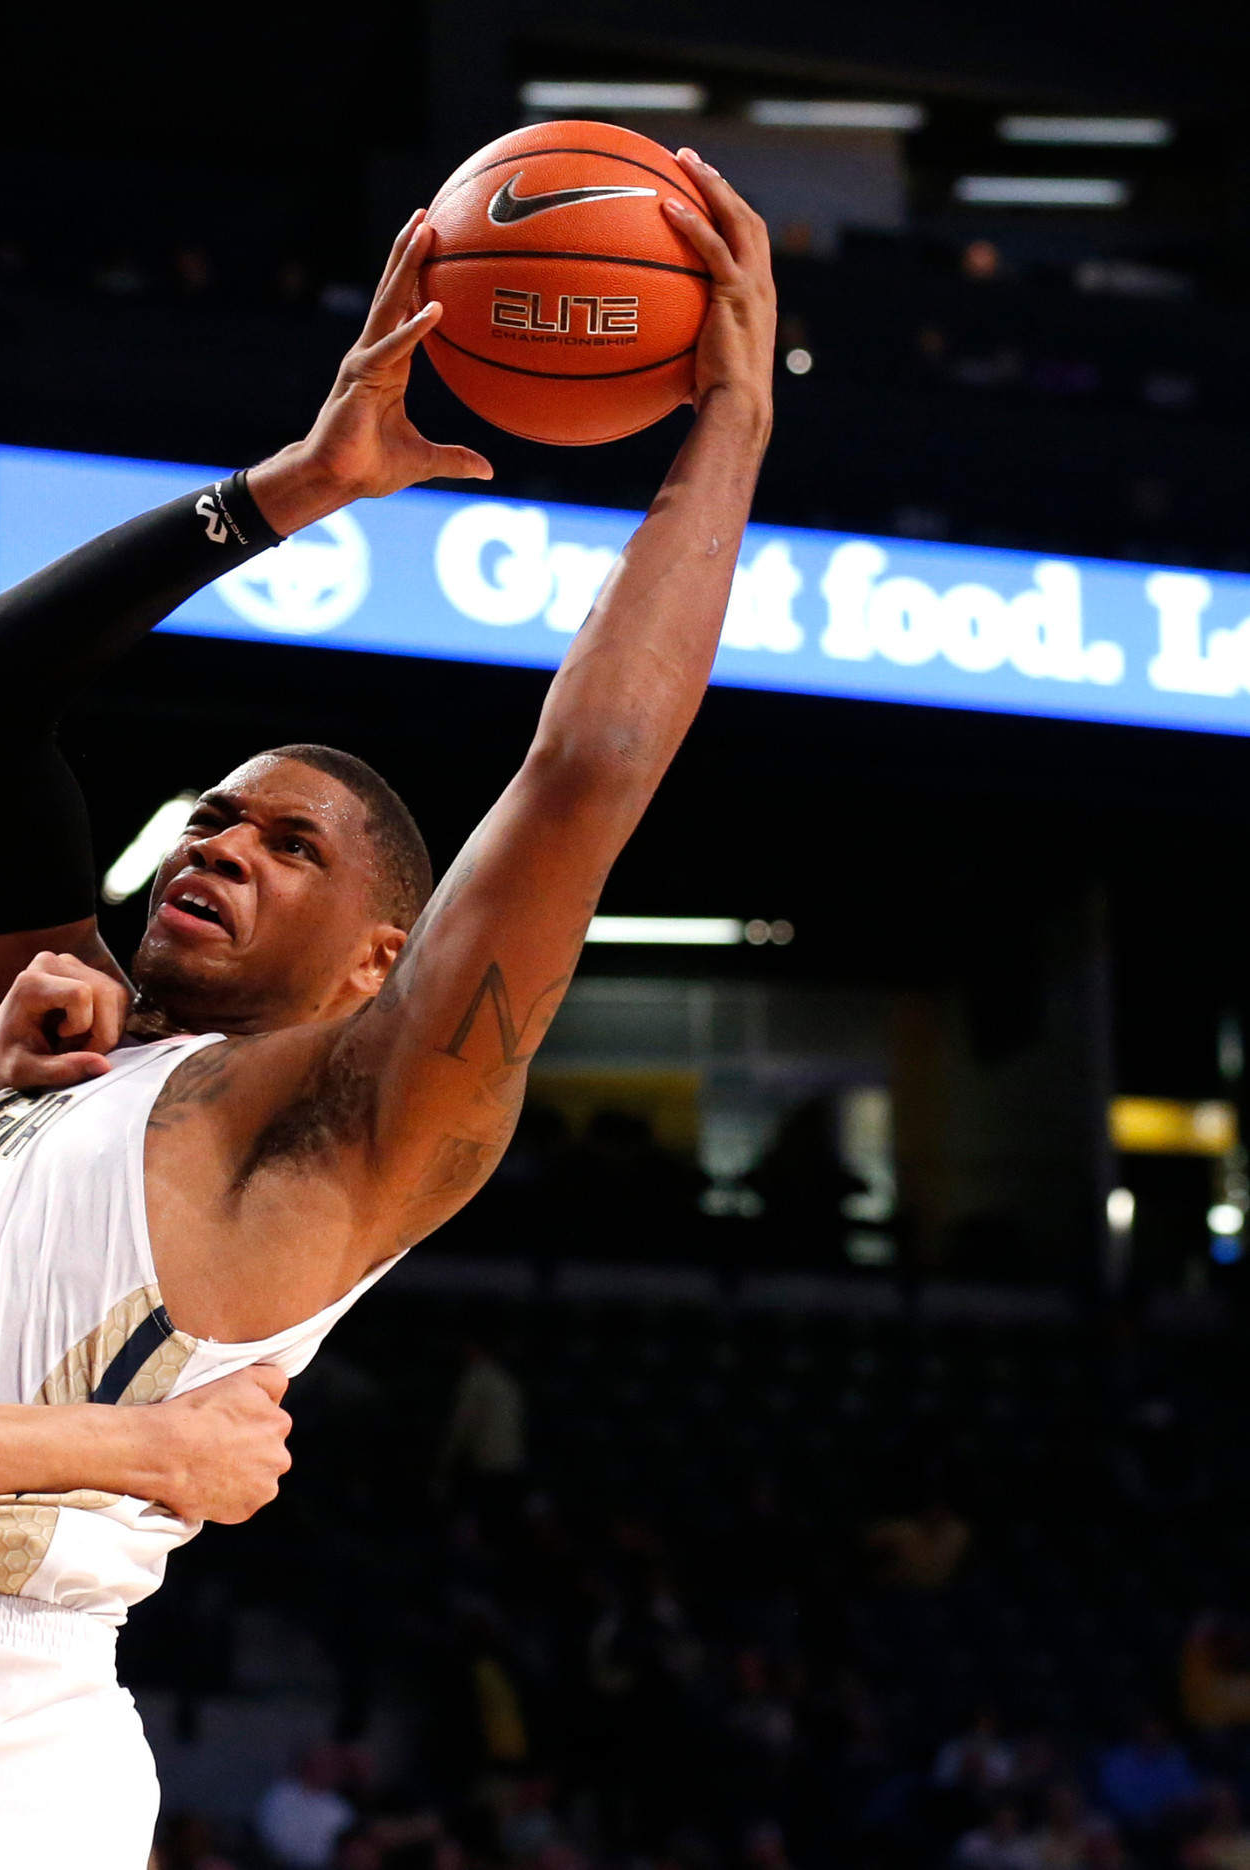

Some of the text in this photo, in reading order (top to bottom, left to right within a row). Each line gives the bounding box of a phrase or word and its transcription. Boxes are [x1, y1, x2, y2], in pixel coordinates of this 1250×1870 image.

[491, 287, 639, 335] ELITE
[491, 328, 638, 347] CHAMPIONSHIP
[434, 502, 1250, 698] Grt food. L
